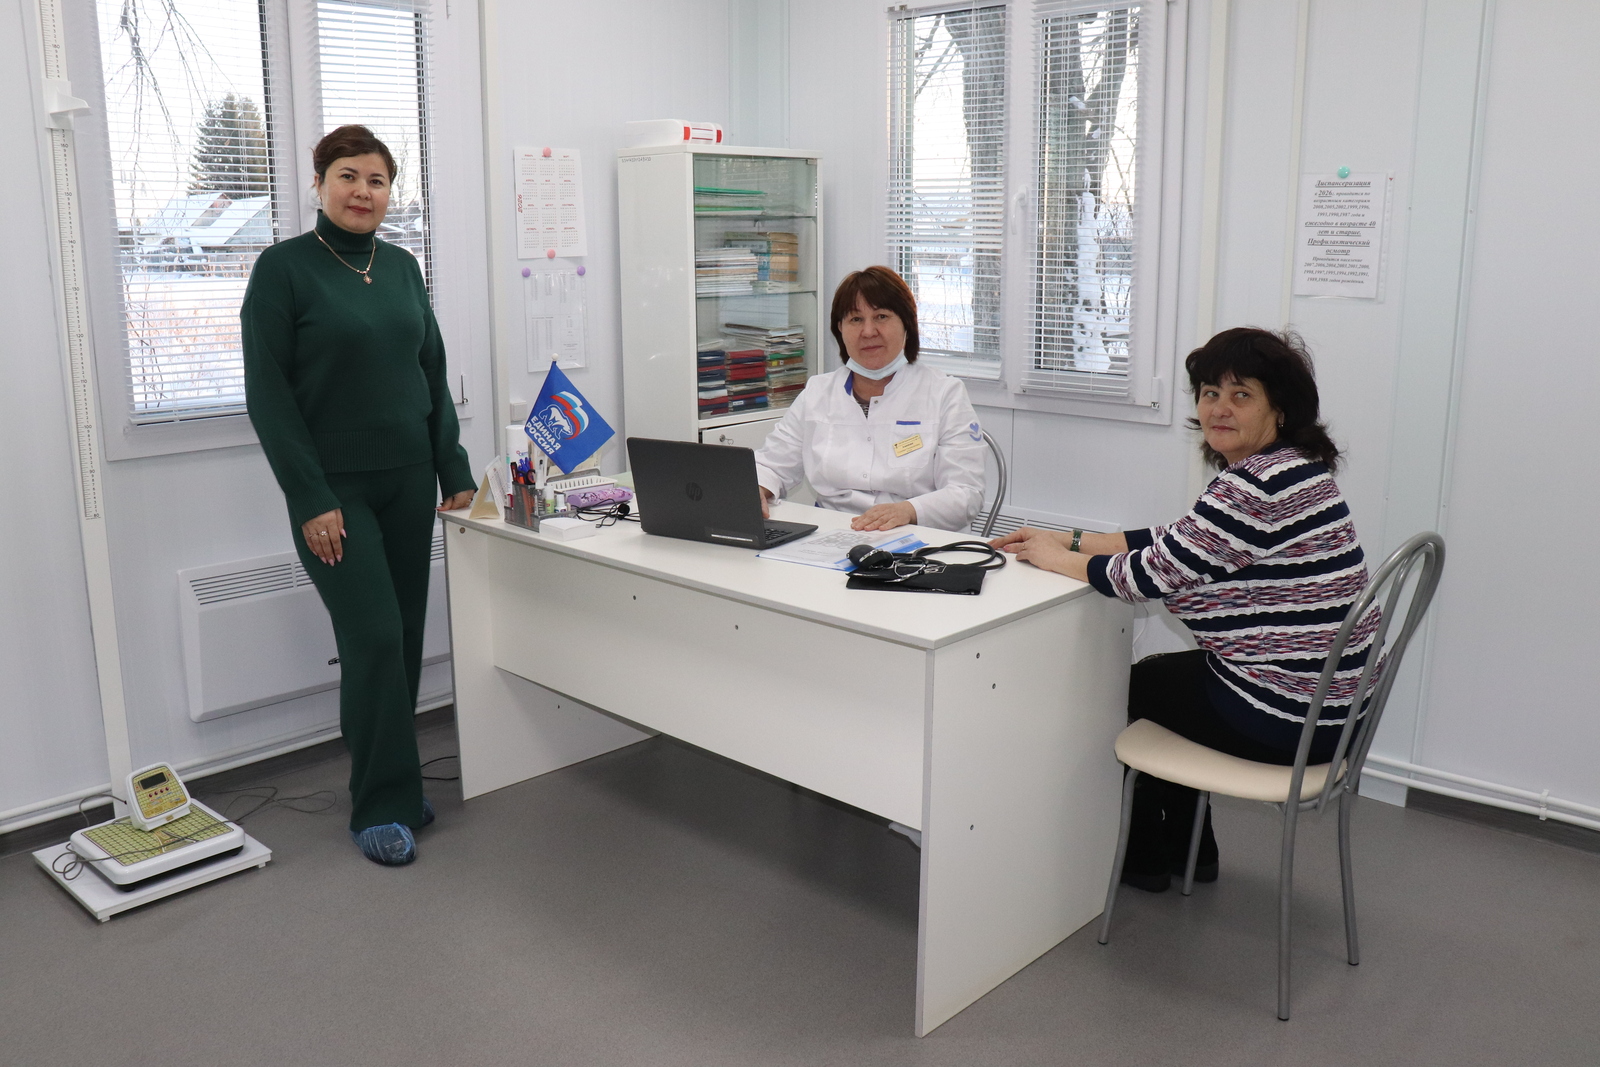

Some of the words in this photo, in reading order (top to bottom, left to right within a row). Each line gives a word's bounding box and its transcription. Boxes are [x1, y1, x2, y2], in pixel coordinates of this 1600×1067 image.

[526, 422, 555, 455] РОССИЯ
[530, 416, 561, 450] ЕДИНАЯ
[688, 482, 702, 500] hp
